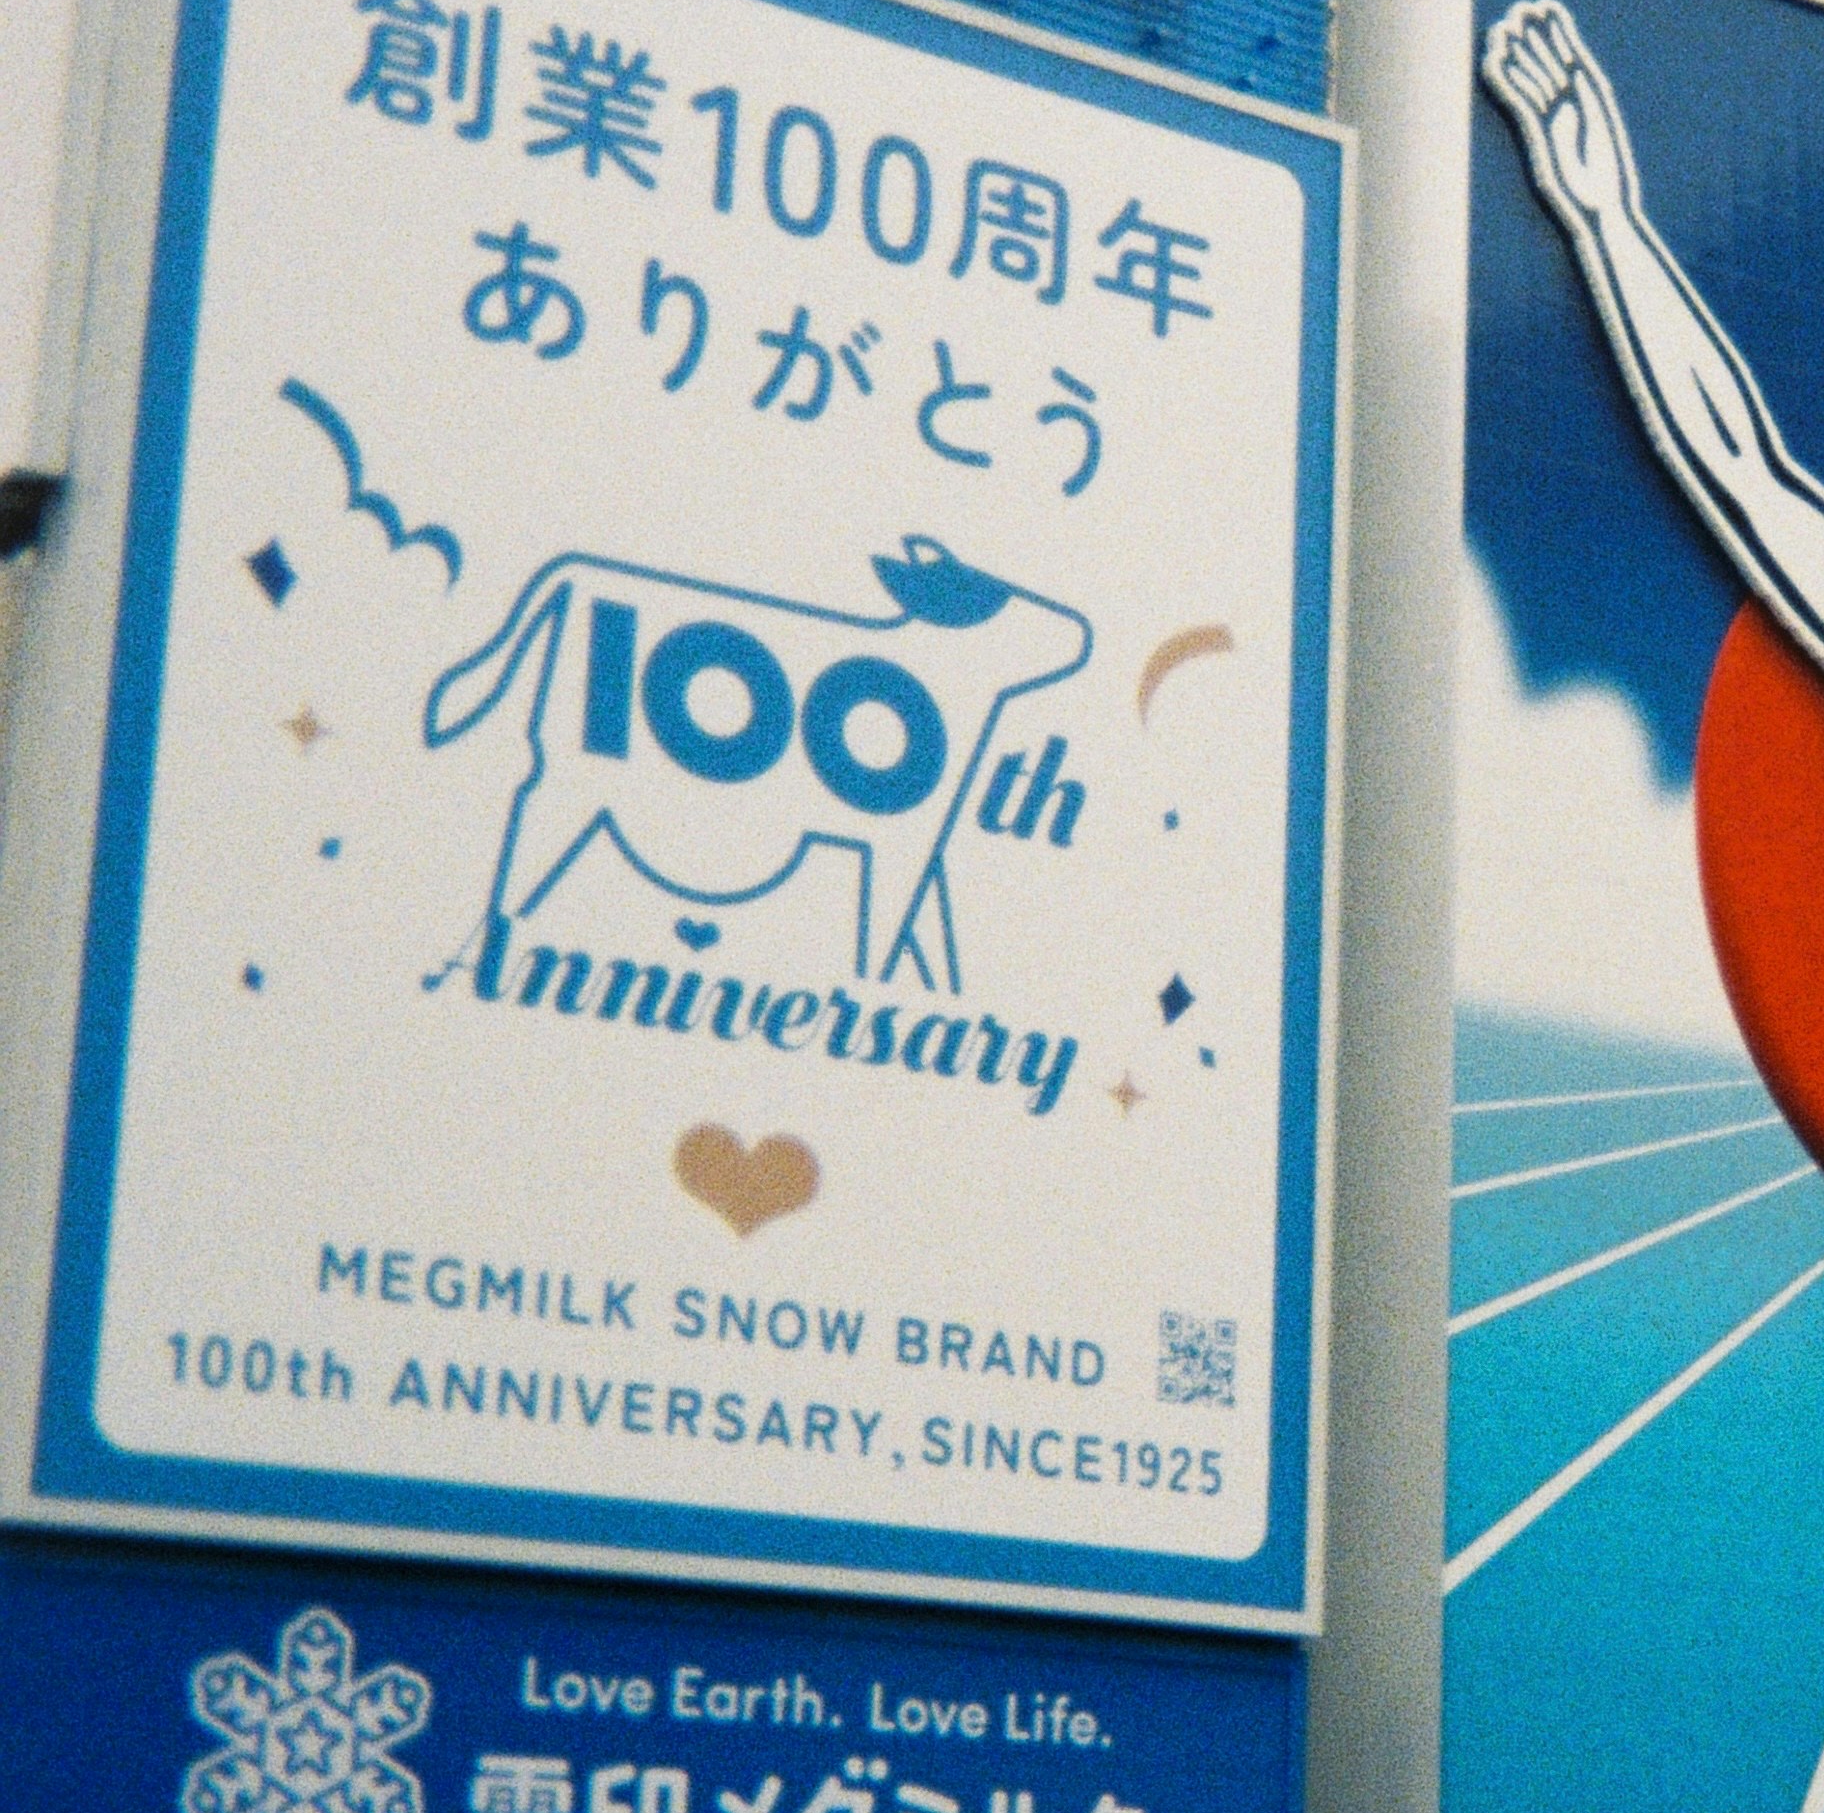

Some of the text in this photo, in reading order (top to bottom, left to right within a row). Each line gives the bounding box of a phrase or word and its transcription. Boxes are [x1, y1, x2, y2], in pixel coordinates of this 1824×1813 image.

[462, 220, 1104, 498] ありがとう
[421, 912, 1080, 1116] Anniversary
[163, 1331, 356, 1405] 100th
[316, 1243, 1110, 1389] MEGMILK SNOW BRAND
[523, 1656, 1113, 1748] Love Earth. Love Life.
